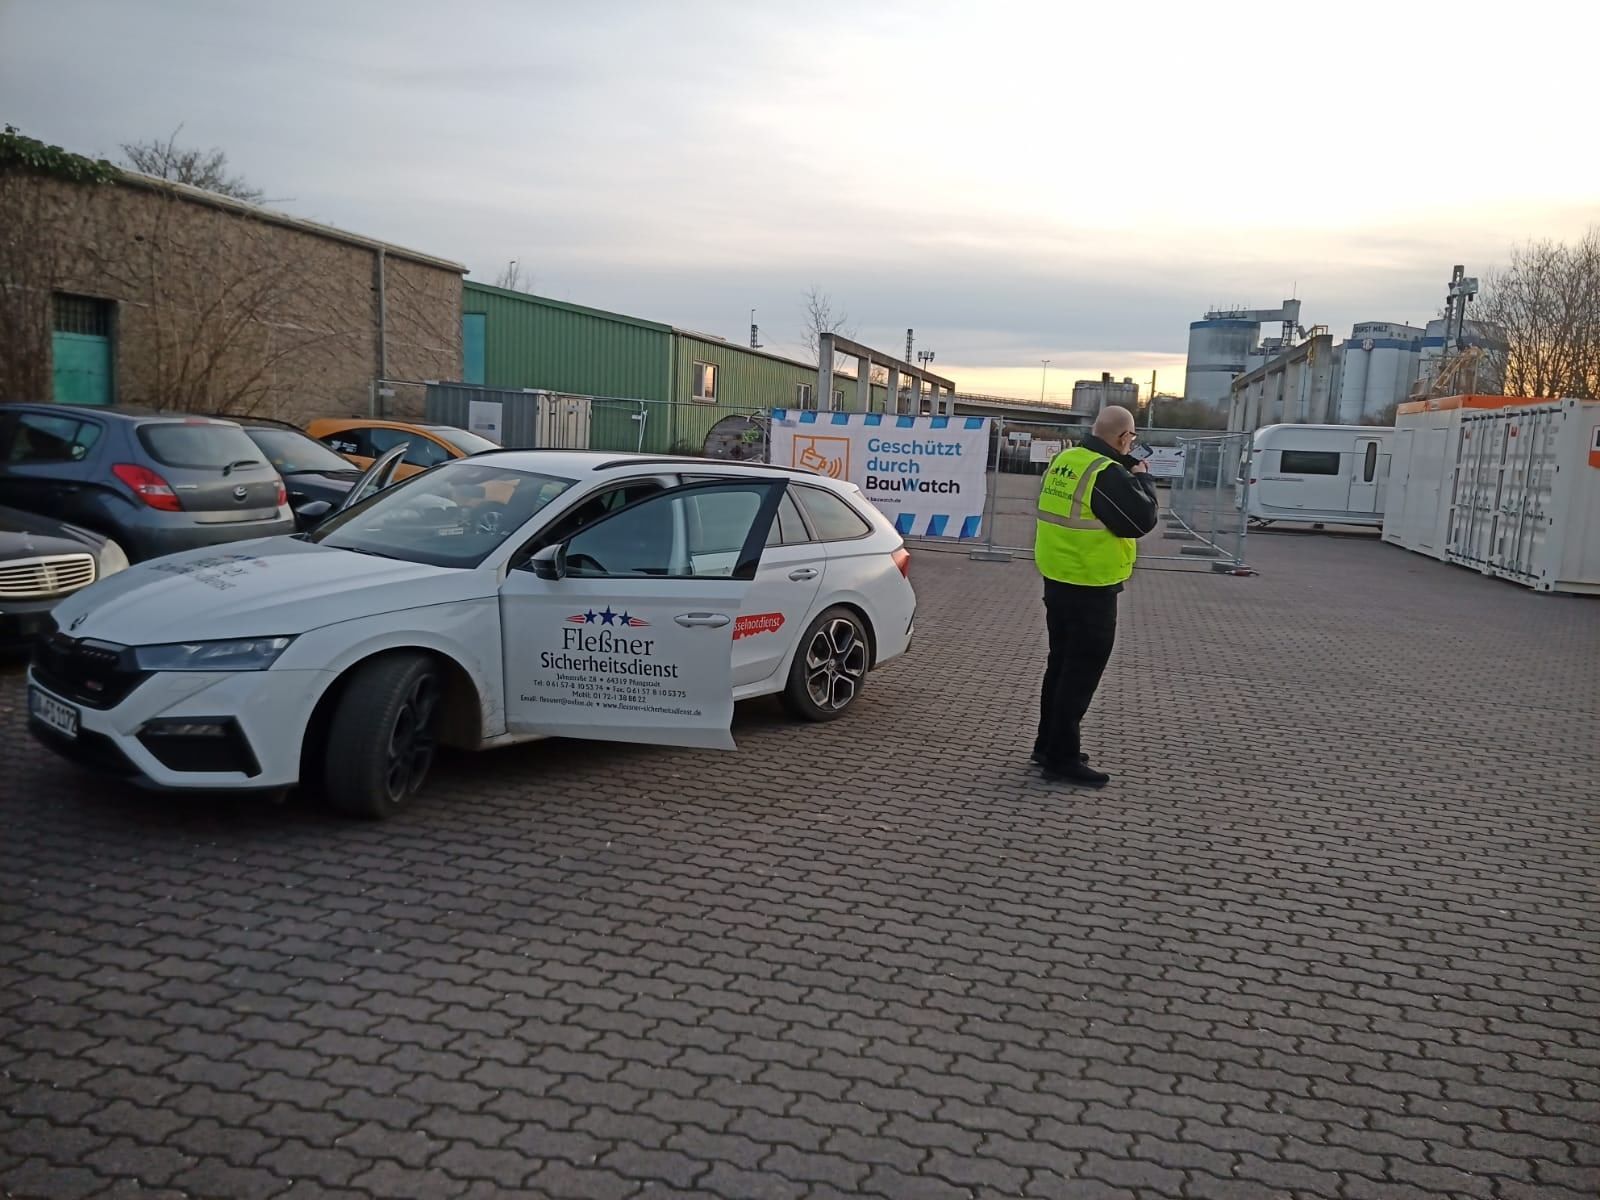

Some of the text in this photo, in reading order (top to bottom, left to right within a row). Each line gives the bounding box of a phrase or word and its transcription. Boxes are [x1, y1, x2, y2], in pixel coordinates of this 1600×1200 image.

[867, 438, 962, 456] Geschützt
[867, 456, 920, 474] durch
[865, 475, 960, 494] BauWatch
[562, 627, 654, 656] Fleßner
[540, 651, 679, 678] Sicherheitsdienst
